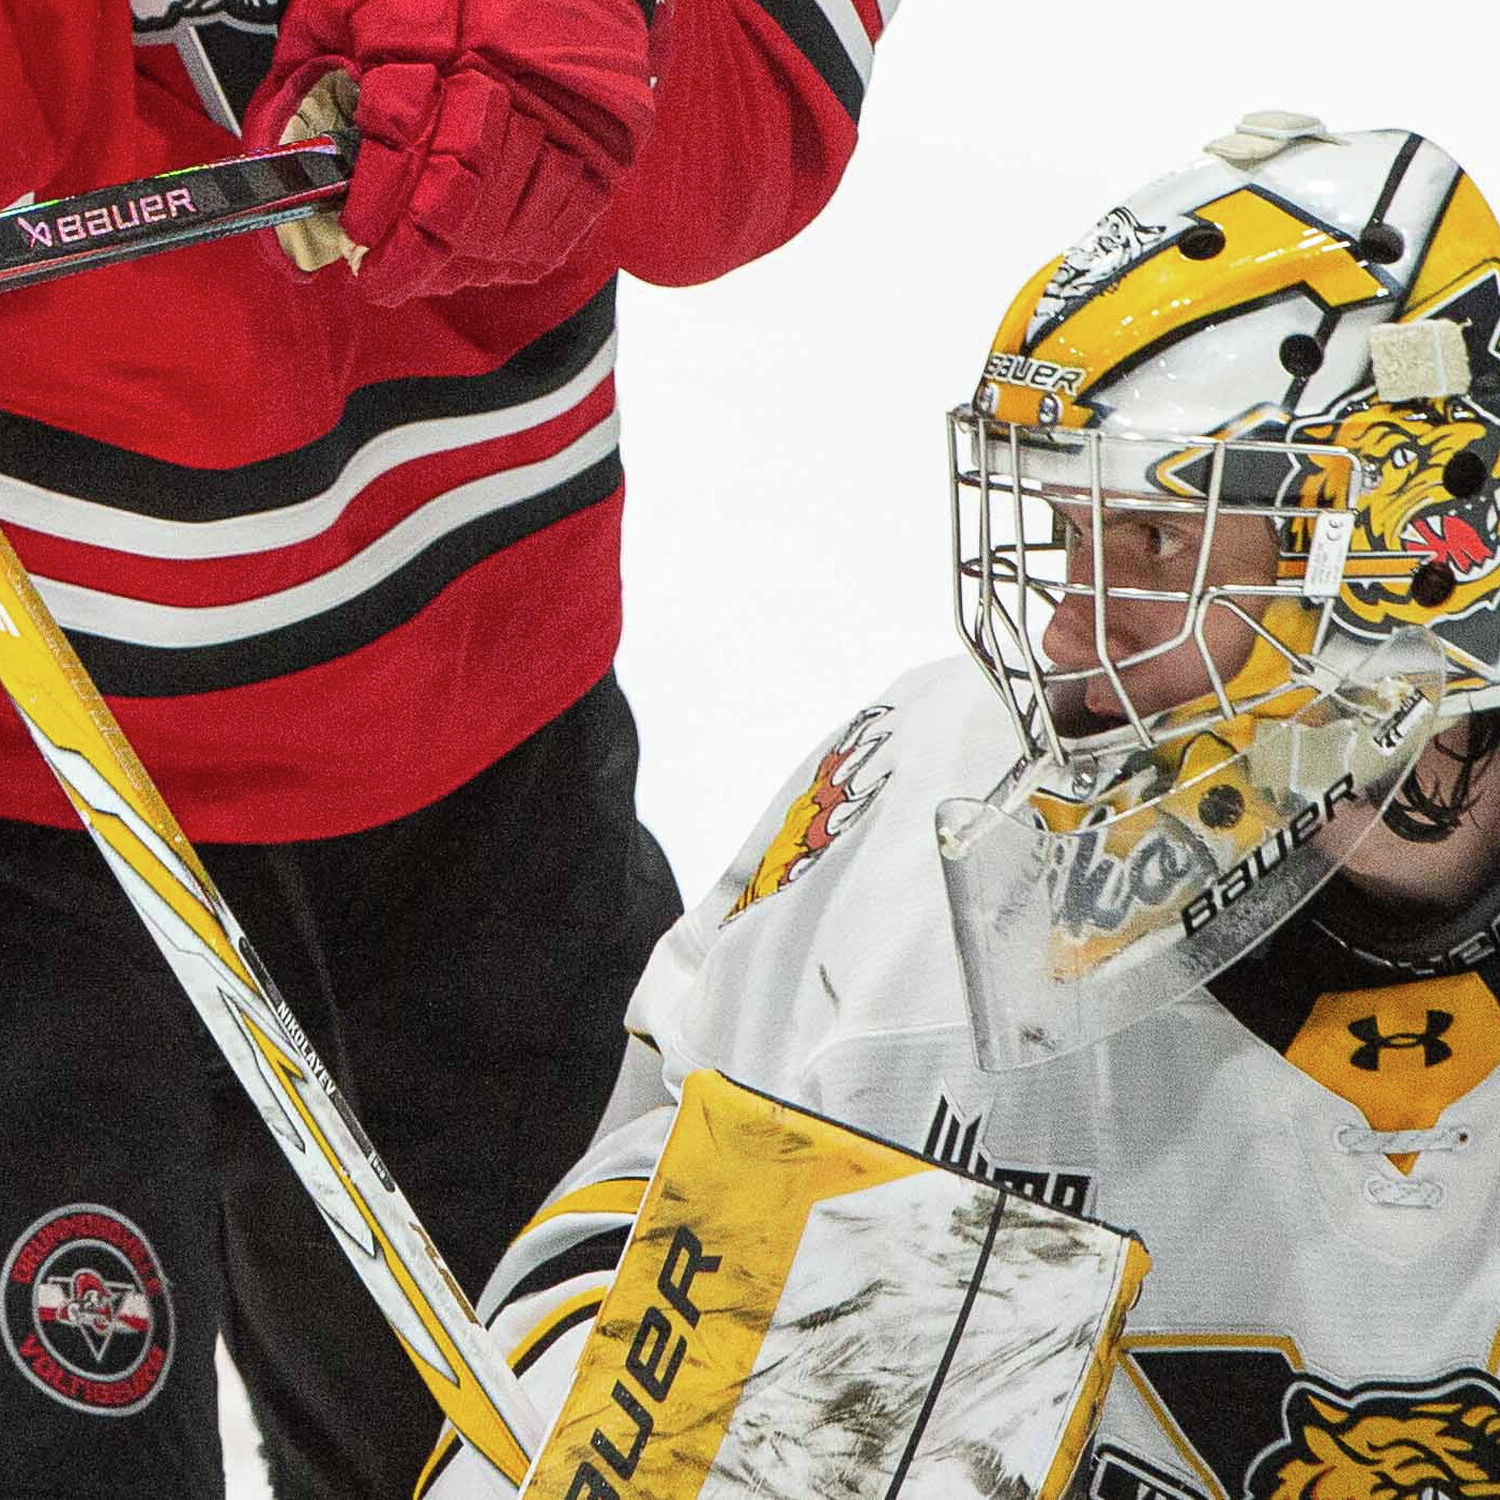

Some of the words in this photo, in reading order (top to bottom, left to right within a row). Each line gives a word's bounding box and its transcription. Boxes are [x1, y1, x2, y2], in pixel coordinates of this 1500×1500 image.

[57, 187, 198, 245] BAUER
[1181, 772, 1359, 938] BAUER
[276, 1000, 337, 1098] NIKOLAYEV
